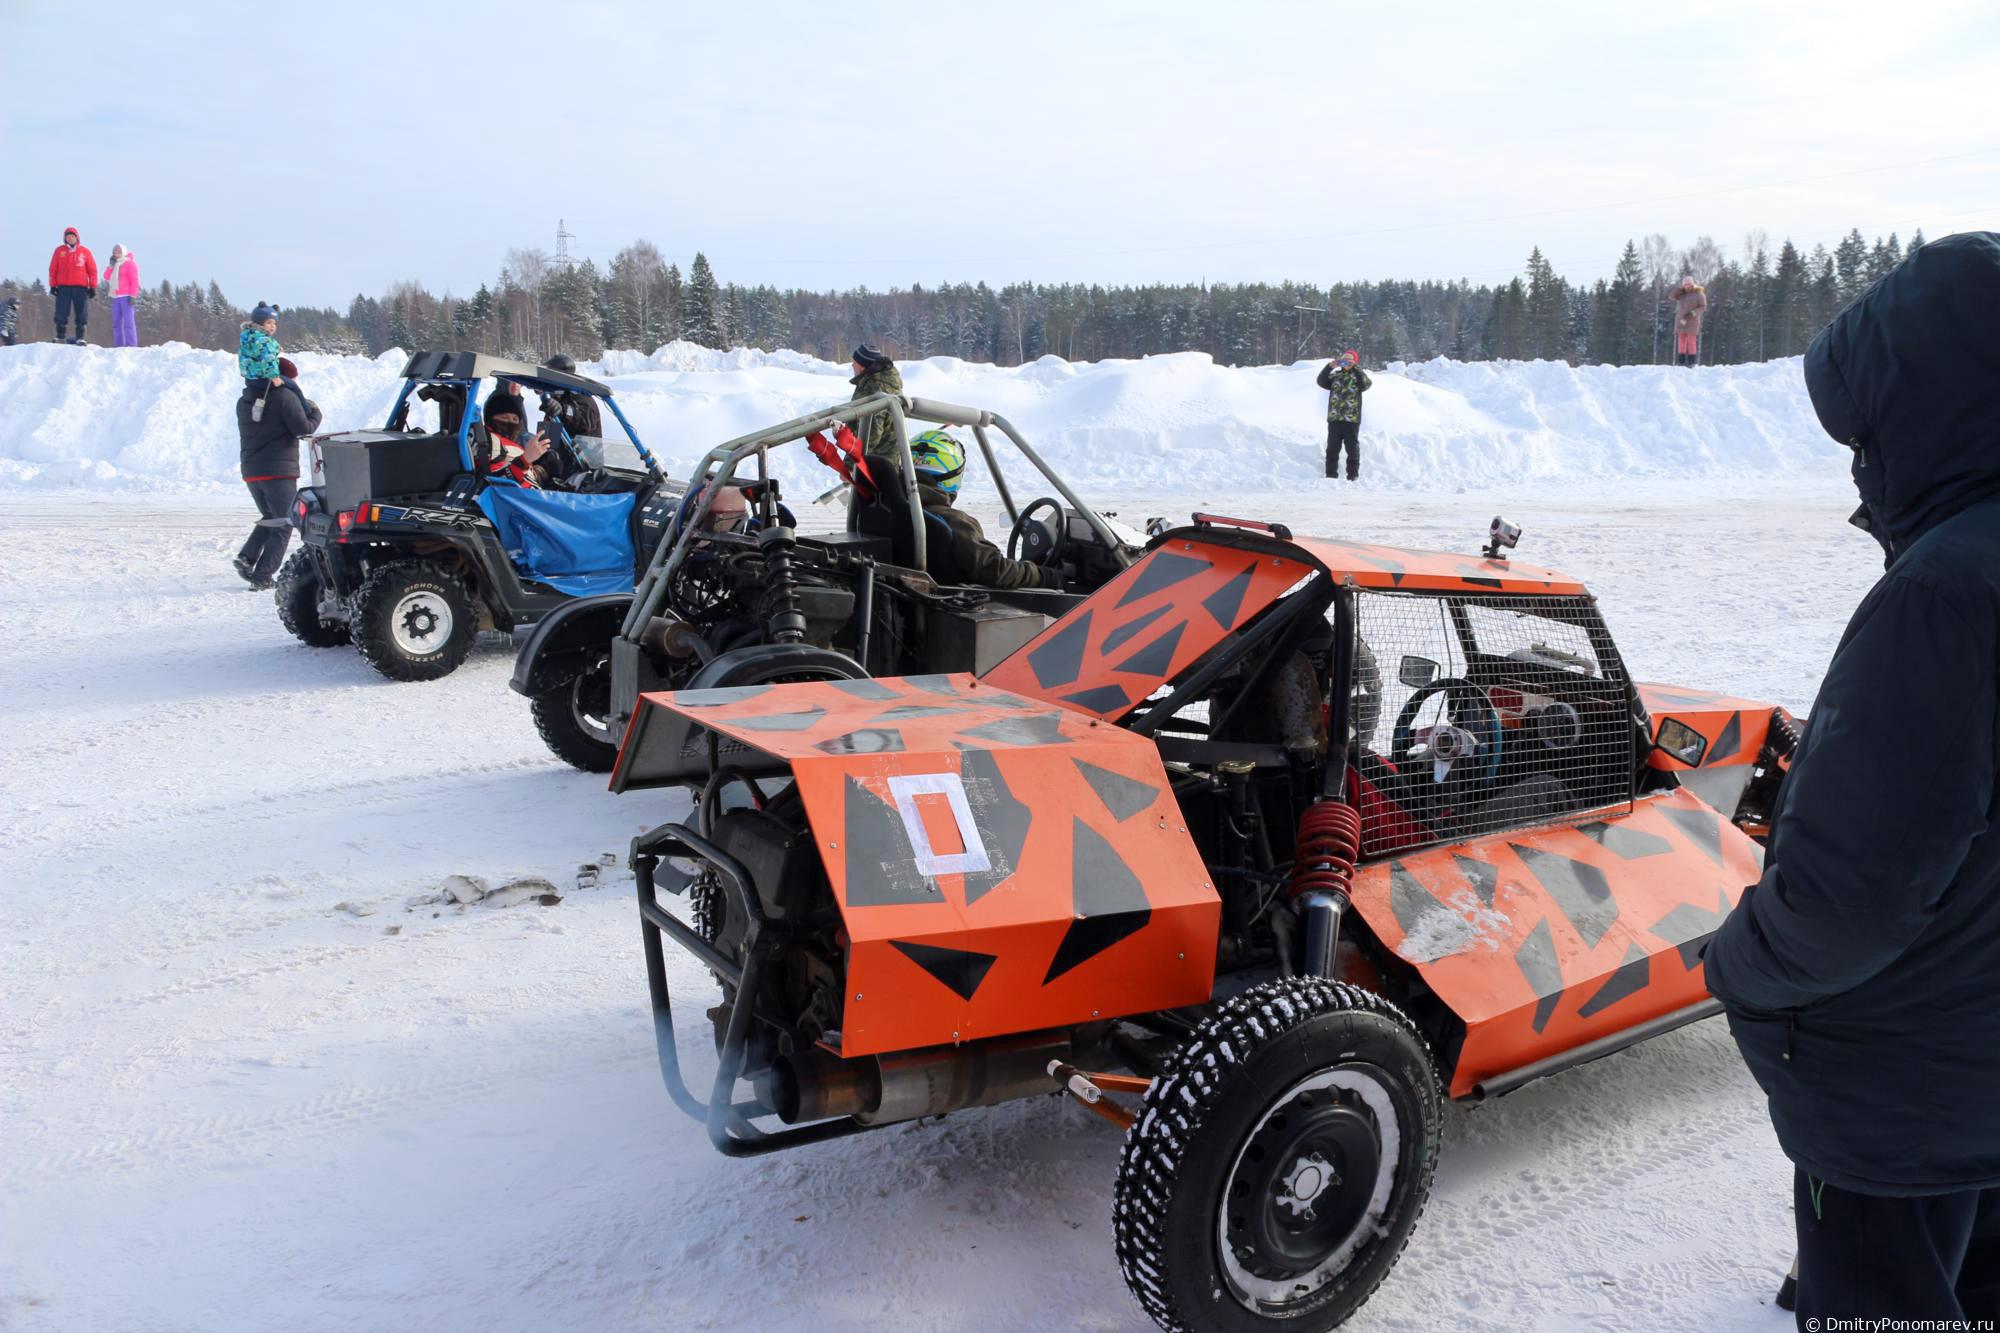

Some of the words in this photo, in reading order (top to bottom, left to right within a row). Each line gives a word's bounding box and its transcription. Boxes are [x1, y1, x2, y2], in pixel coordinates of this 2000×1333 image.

[401, 507, 479, 528] RZR
[404, 583, 446, 593] BIGHORN
[405, 652, 443, 662] MAXXIS
